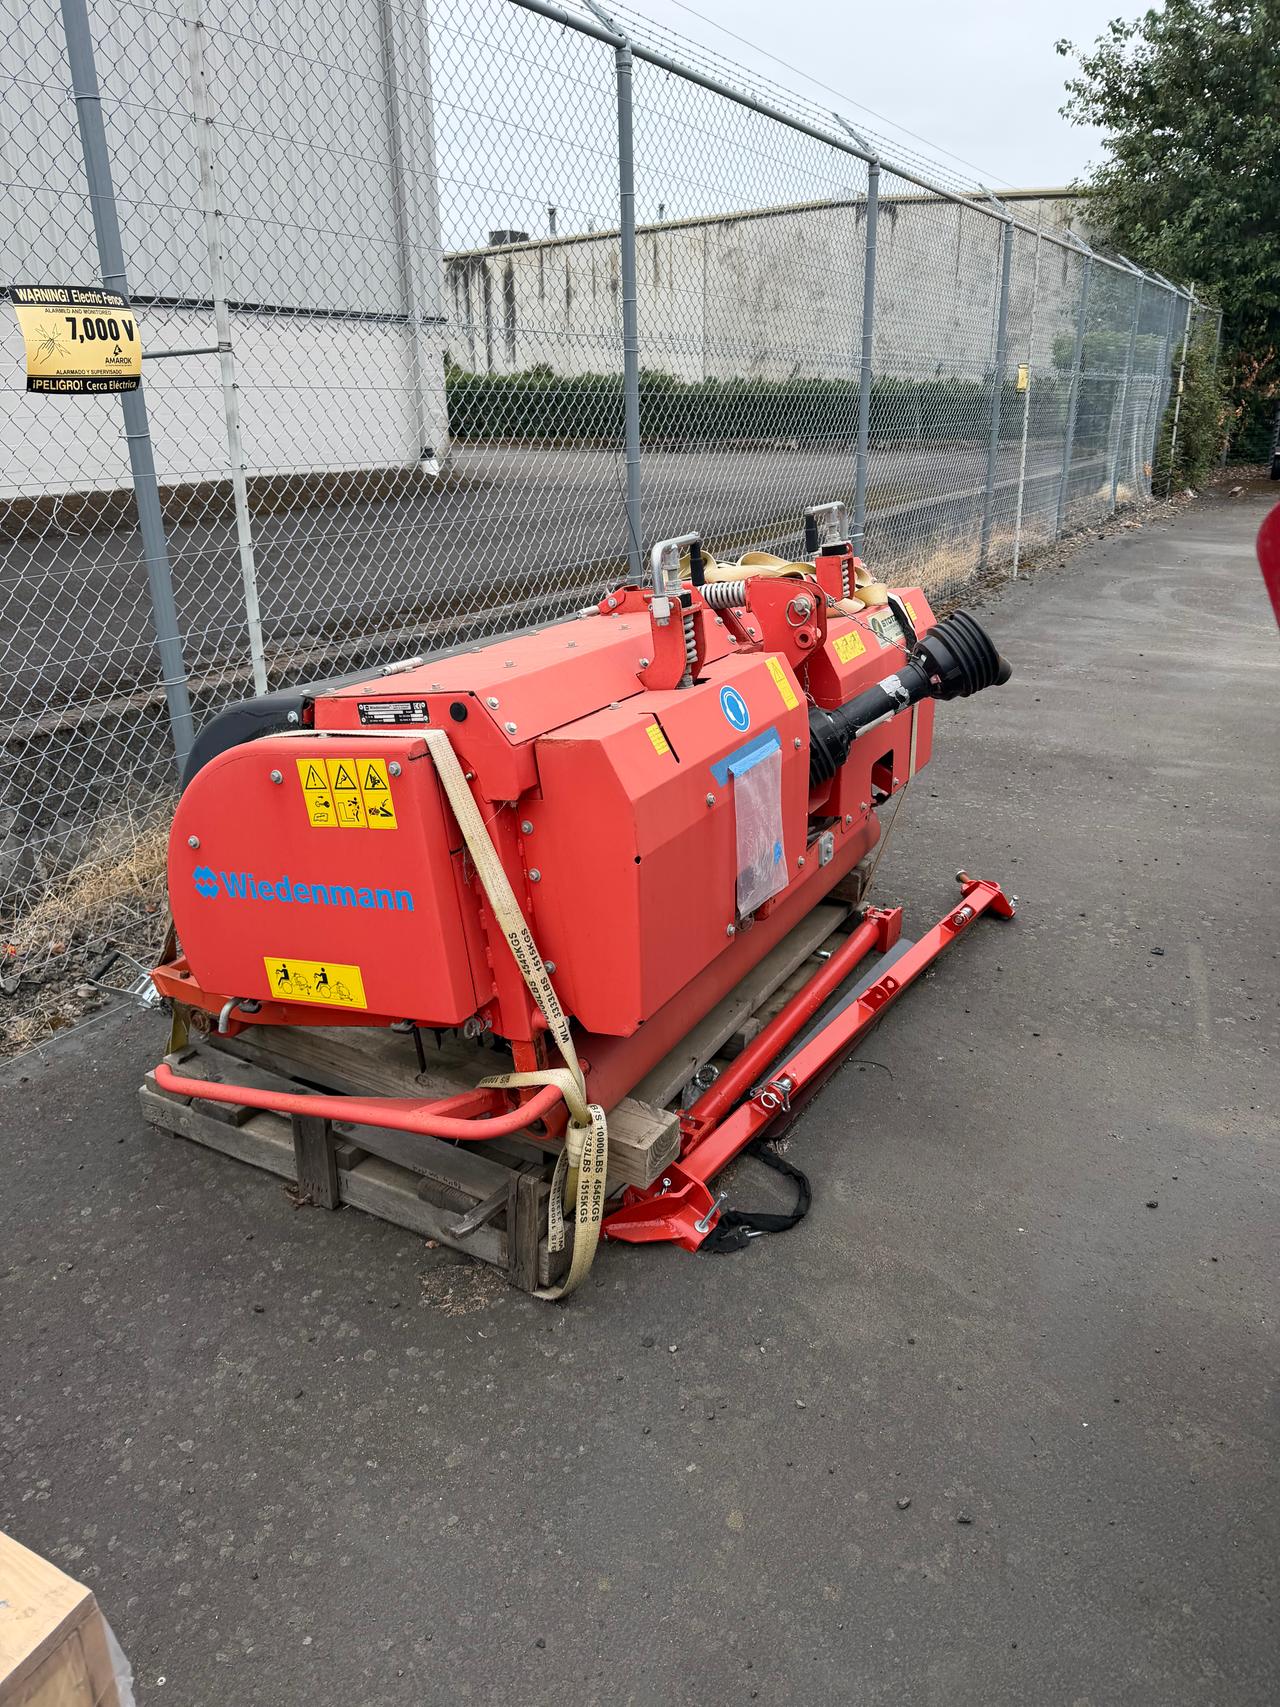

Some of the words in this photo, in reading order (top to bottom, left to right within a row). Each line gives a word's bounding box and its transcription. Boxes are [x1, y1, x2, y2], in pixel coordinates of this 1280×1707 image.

[15, 288, 70, 302] WARNING!
[71, 289, 102, 304] Electric
[102, 292, 124, 305] Fence
[65, 317, 120, 343] 7,000
[122, 319, 134, 342] V
[33, 379, 84, 390] ¡PELIGRO!
[86, 381, 108, 390] Cerca
[109, 380, 137, 391] Eléctrica
[219, 871, 415, 912] Wiedenmann
[508, 932, 531, 976] 4545KGS
[521, 927, 543, 972] 1515KGS
[540, 976, 562, 1019] 3333LBS
[557, 1021, 569, 1044] WLL
[590, 1104, 602, 1121] B/S
[582, 1131, 593, 1174] 333LBS
[595, 1126, 605, 1174] 10000LBS
[580, 1178, 590, 1224] 1515KGS
[592, 1178, 602, 1222] 4545KGS
